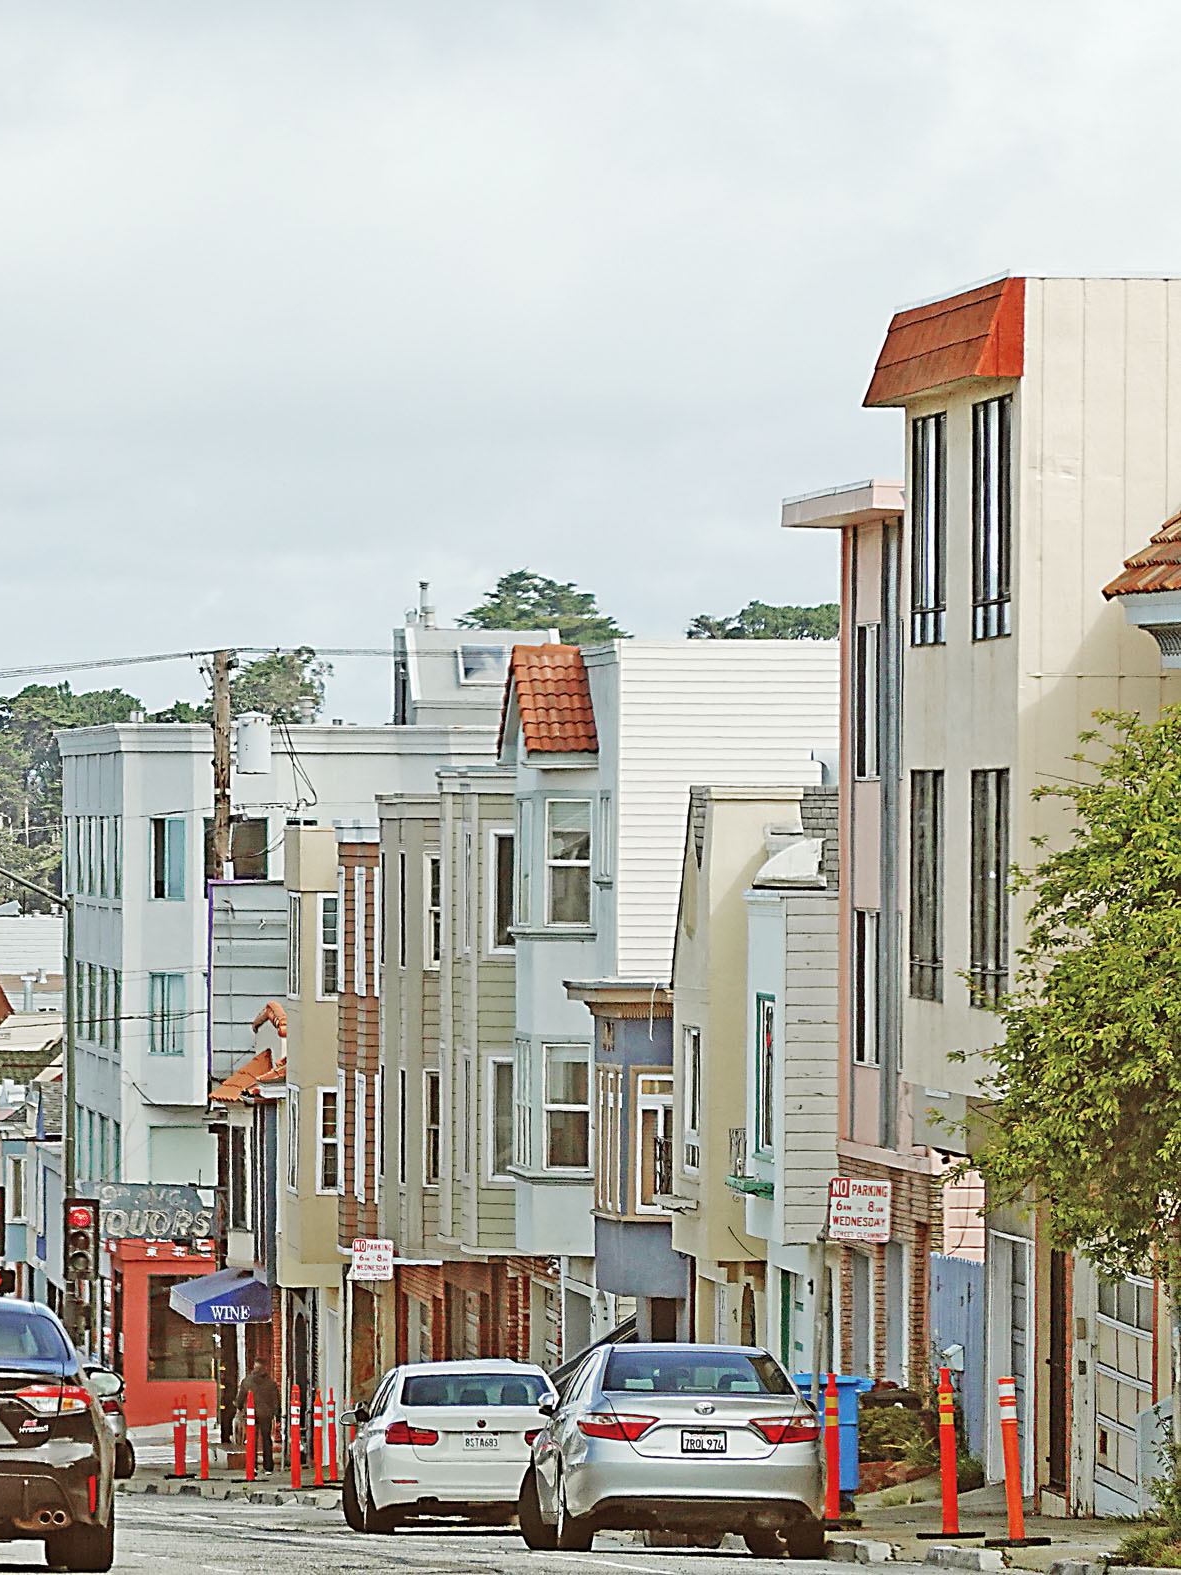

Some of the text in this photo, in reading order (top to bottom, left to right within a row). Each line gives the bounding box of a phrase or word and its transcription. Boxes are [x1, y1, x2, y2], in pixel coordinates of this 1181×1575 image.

[832, 1180, 889, 1198] NO PARKING
[832, 1216, 886, 1227] WEDNESDAY
[354, 1240, 392, 1252] NO PARKING
[356, 1264, 390, 1272] WEDNESDAY
[210, 1305, 251, 1320] WINE
